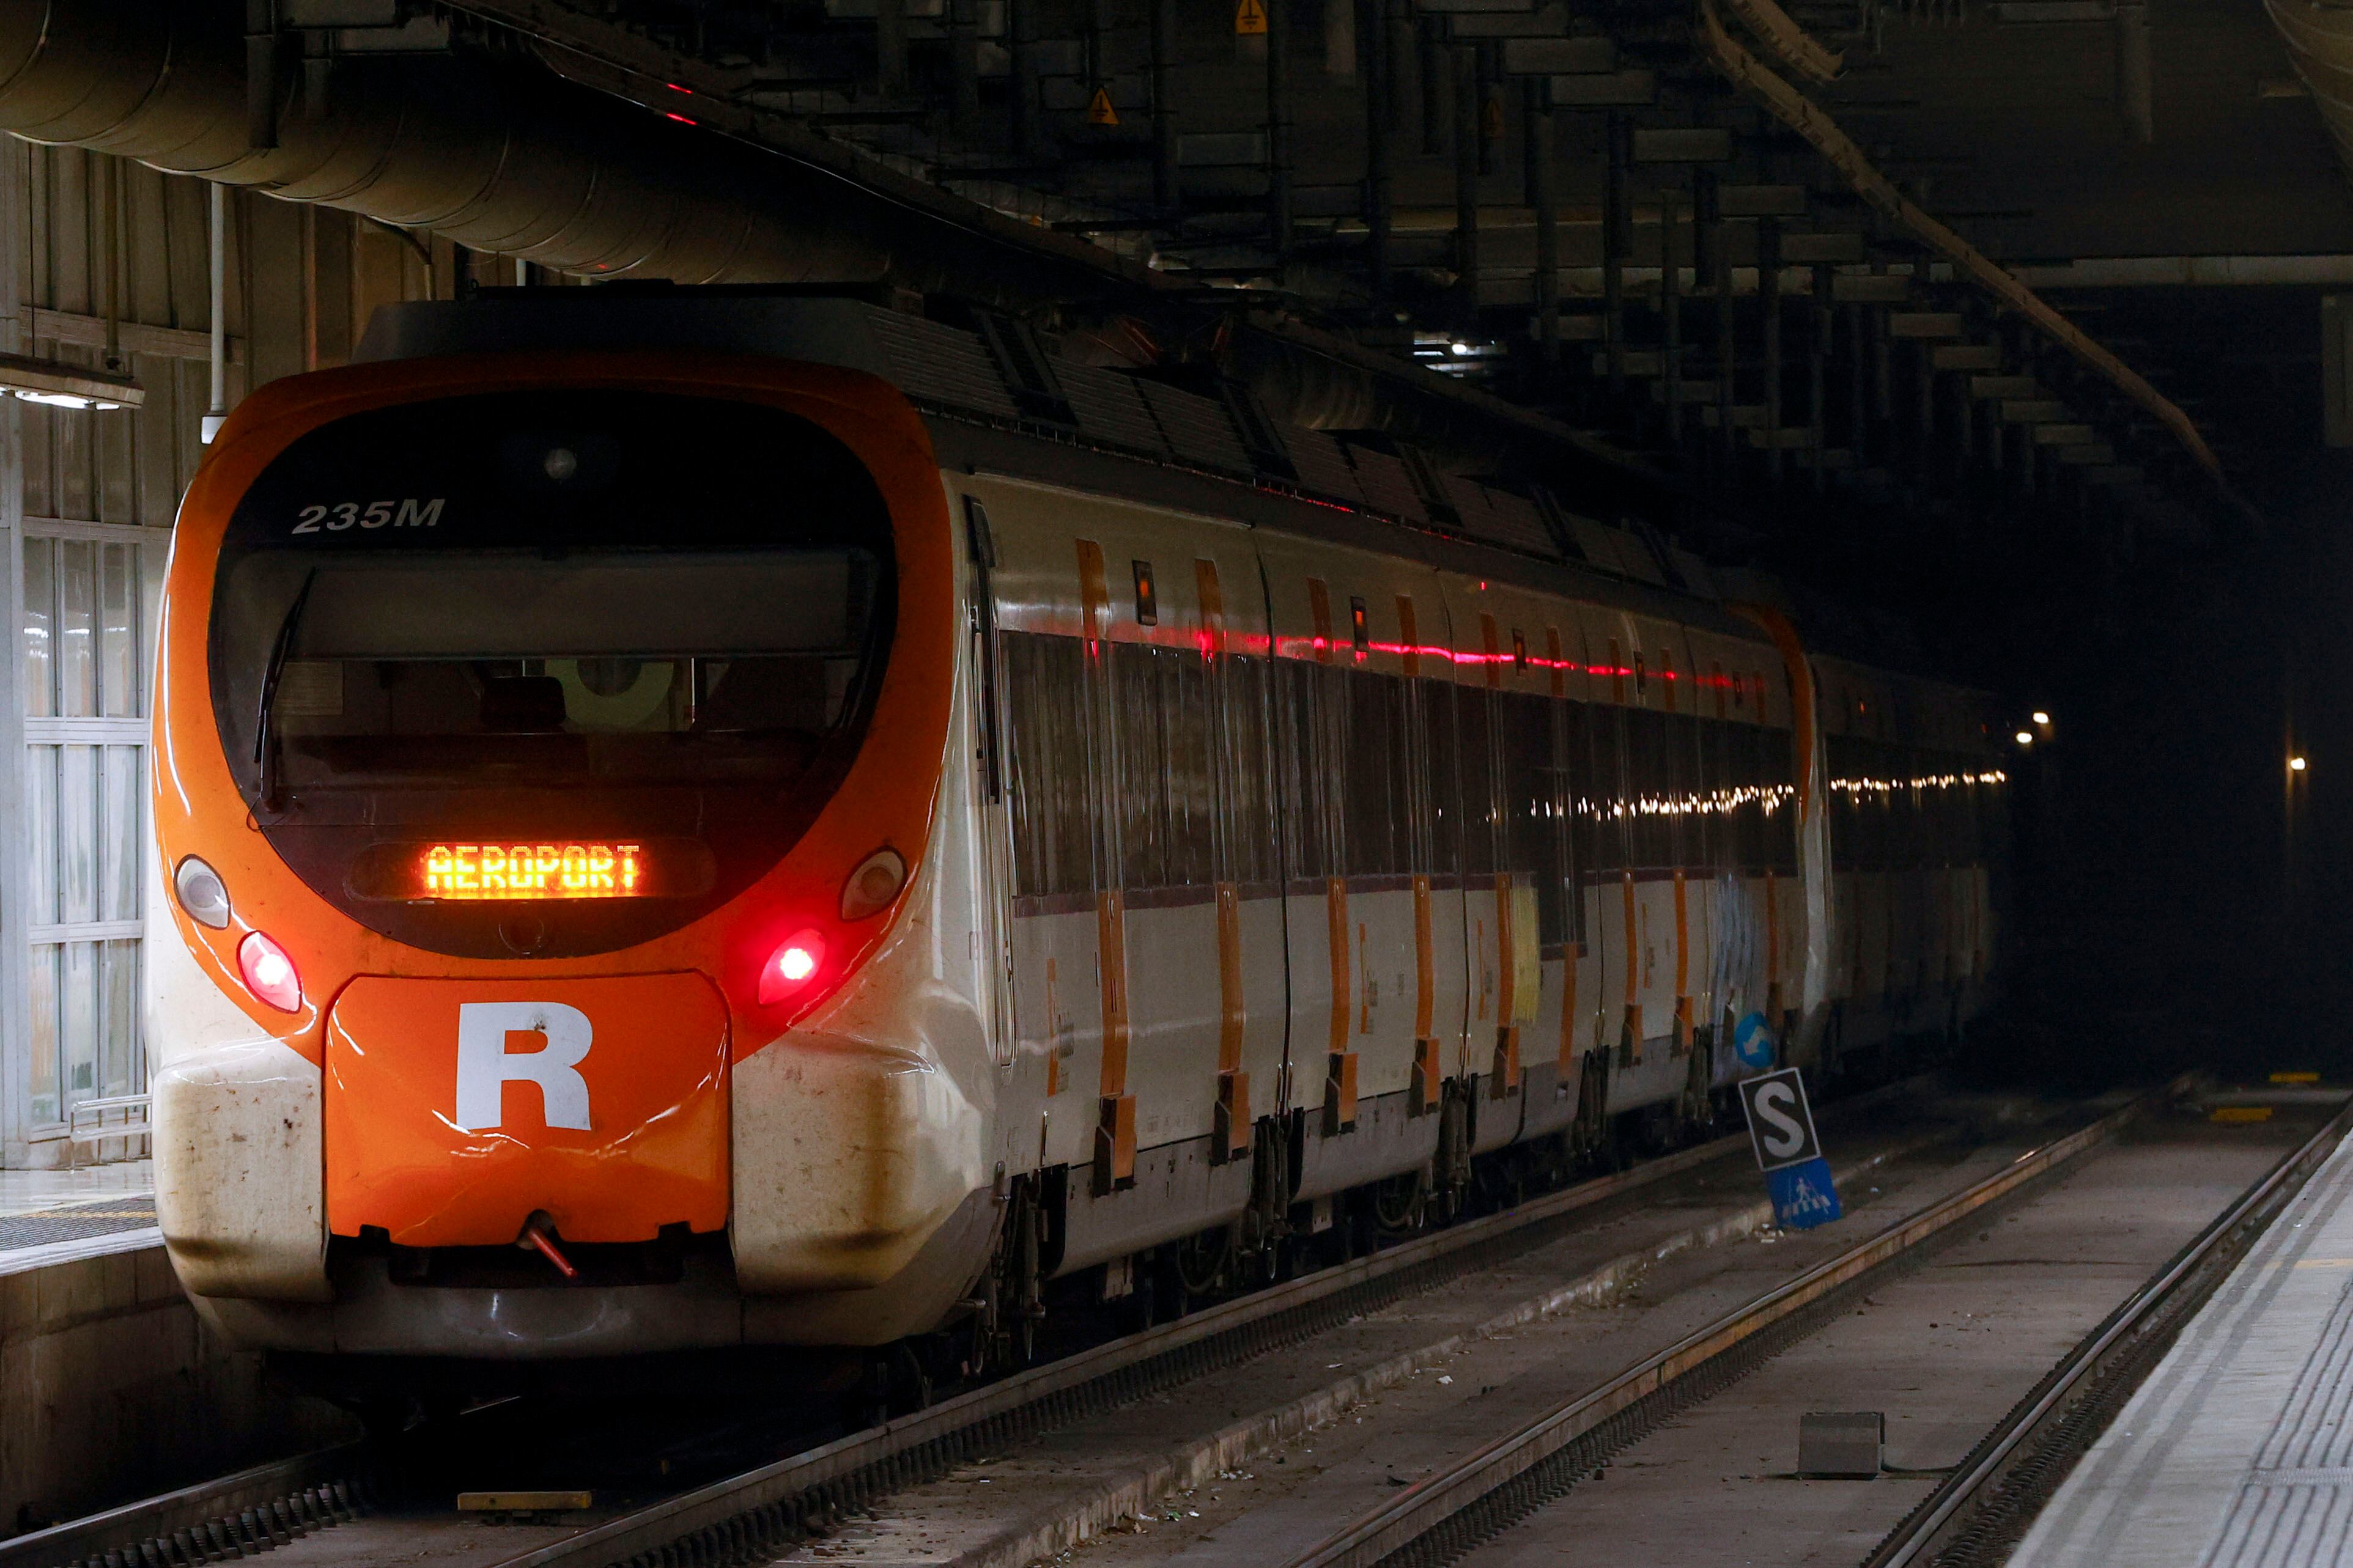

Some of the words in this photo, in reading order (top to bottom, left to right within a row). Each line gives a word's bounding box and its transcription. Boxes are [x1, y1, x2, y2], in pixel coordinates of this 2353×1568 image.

[291, 498, 446, 535] 235M
[427, 845, 640, 889] AEROPORT
[456, 1001, 593, 1131] R
[1754, 1081, 1804, 1158] S
